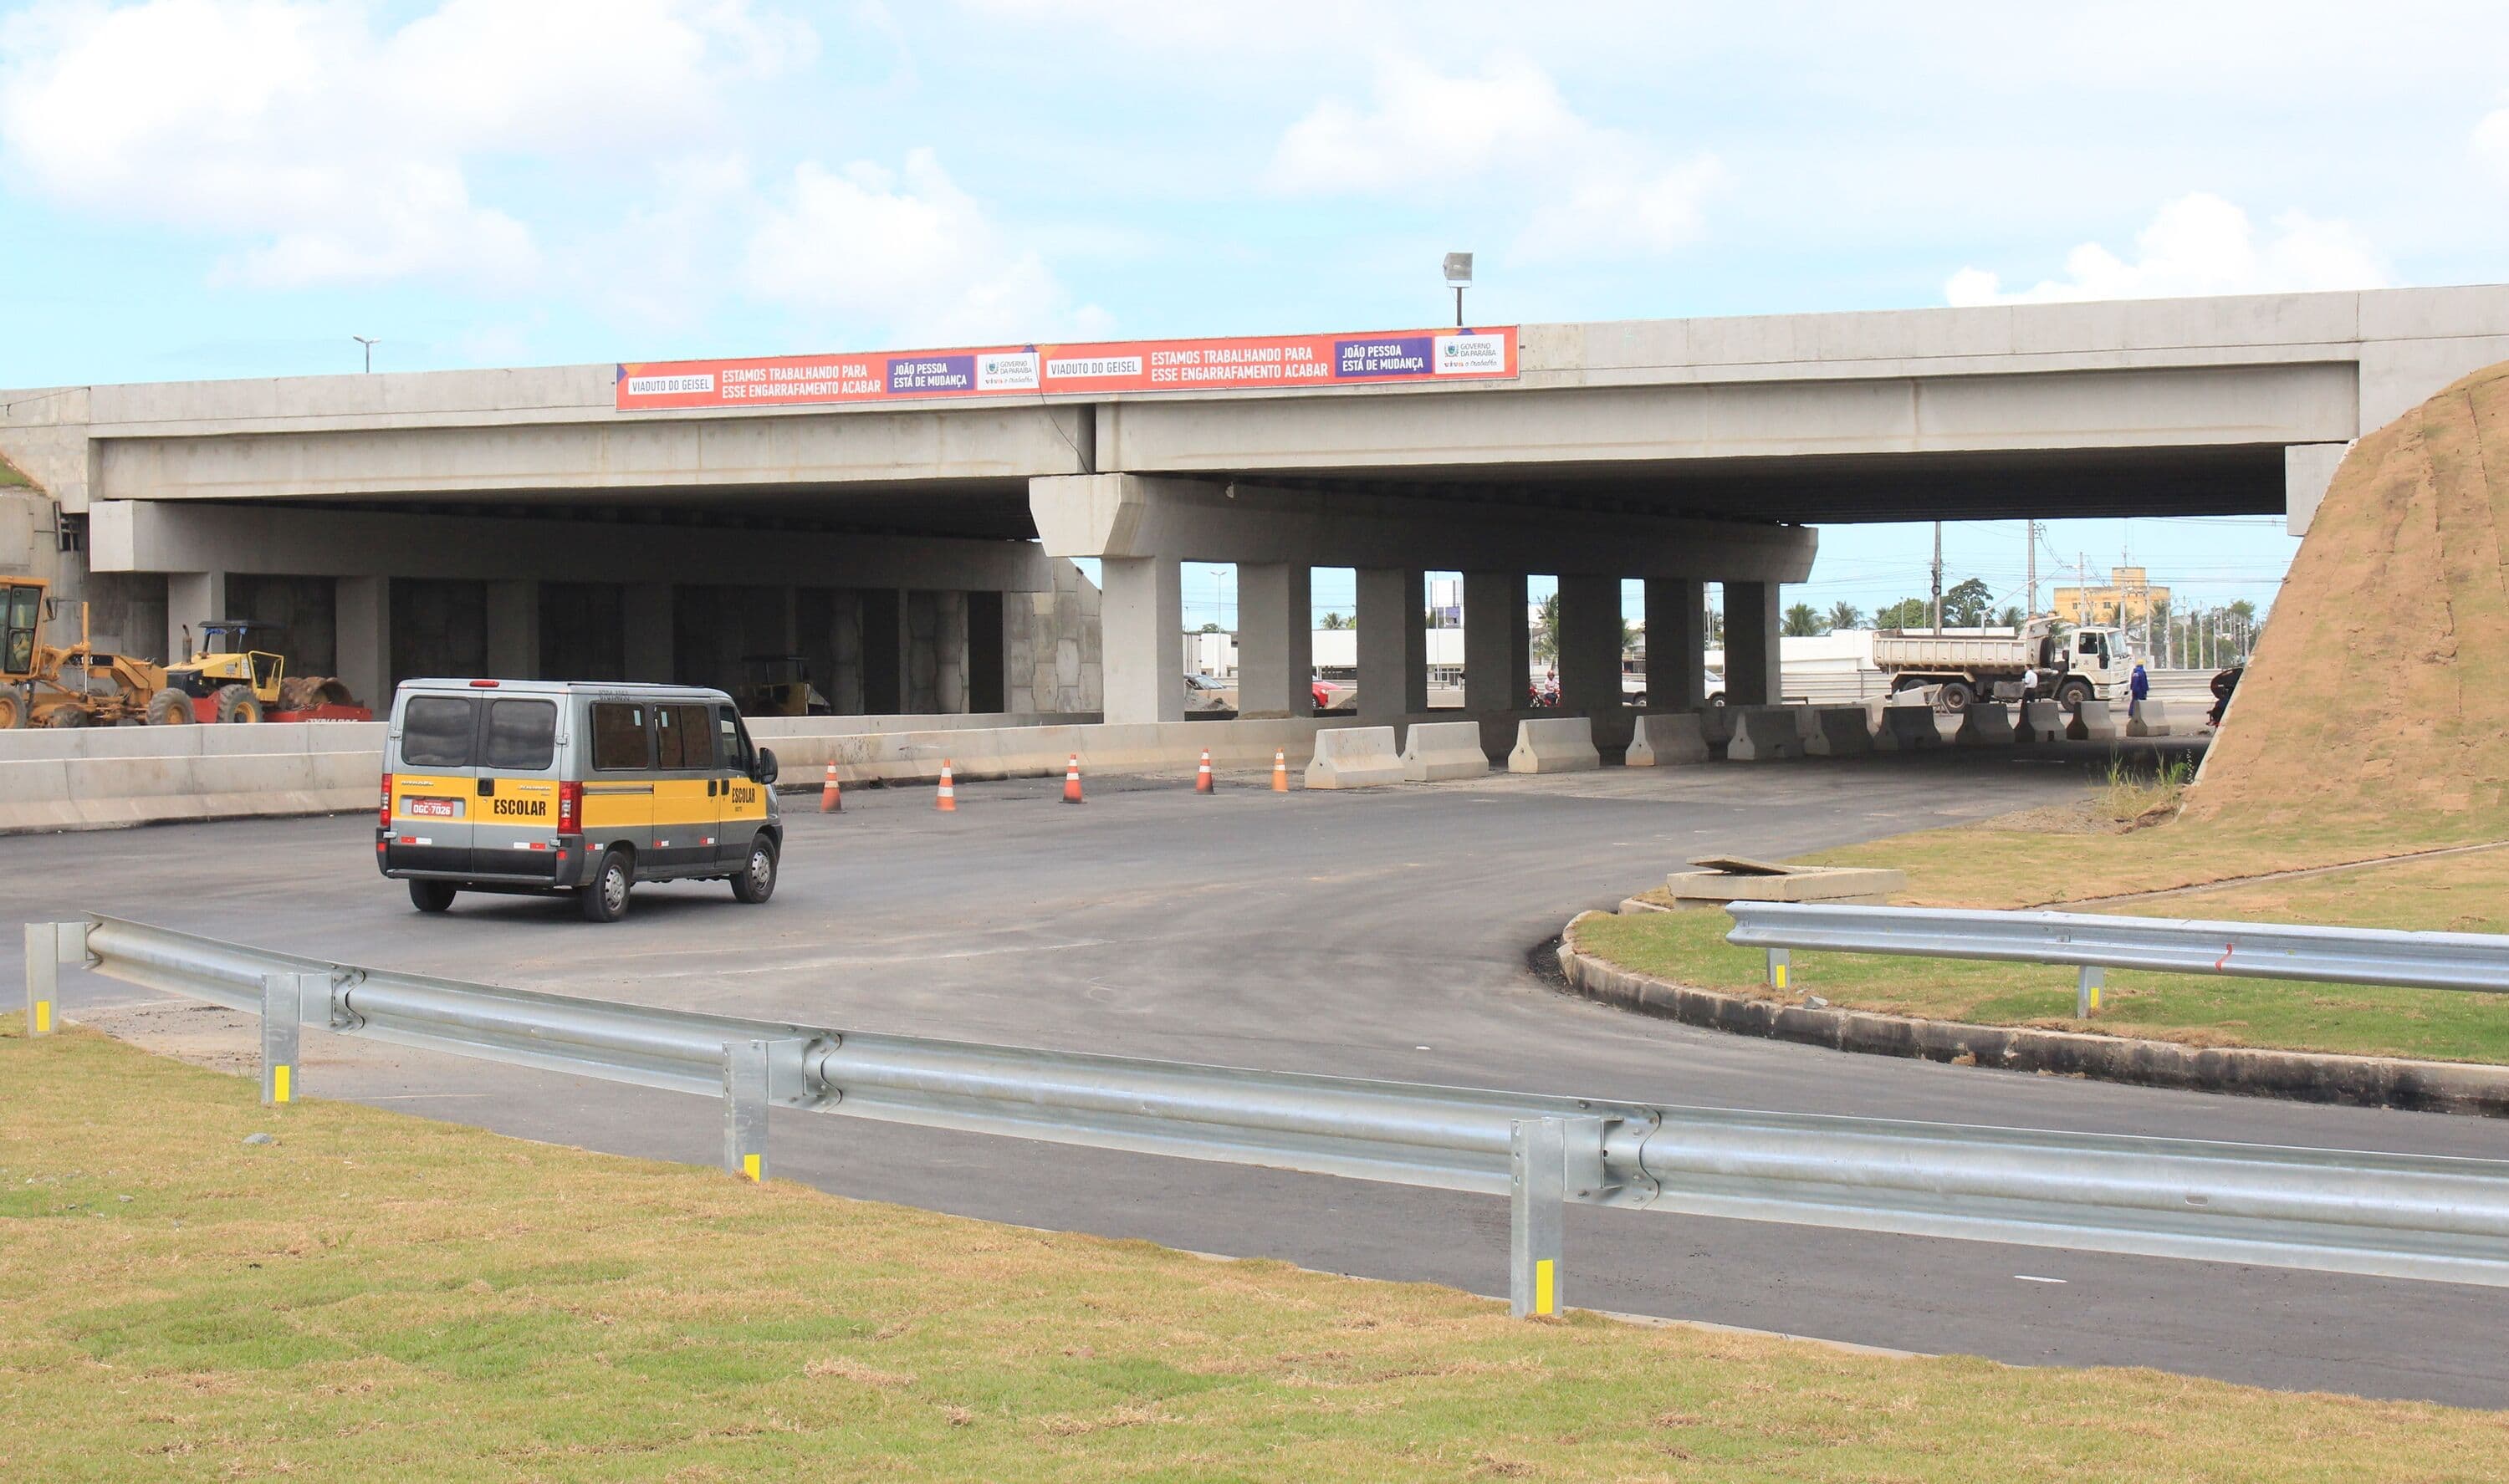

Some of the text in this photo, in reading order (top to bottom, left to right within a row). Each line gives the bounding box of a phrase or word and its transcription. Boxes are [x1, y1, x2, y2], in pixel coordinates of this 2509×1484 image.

[1151, 347, 1312, 366] ESTAMOS TRABALHANDO PARA
[1342, 344, 1402, 359] JOÃO PESSOA
[893, 362, 948, 375] JOÃO PESSOA
[1050, 360, 1137, 375] VIADUTO DO GEISEL
[1342, 357, 1423, 372] ESTÁ DE MUDANÇA
[722, 365, 867, 382] ESTAMOS TRABALHANDO PARA
[1152, 363, 1328, 382] ESSE ENGARRAFAMENTO ACABAR
[632, 378, 710, 392] VIADUTO DO GEISEL
[722, 380, 881, 399] ESSE ENGARRAFAMENTO ACABAR
[894, 375, 968, 389] ESTÁ DE MUDANÇA
[732, 788, 755, 803] ESCOLAR
[493, 798, 546, 816] ESCOLAR
